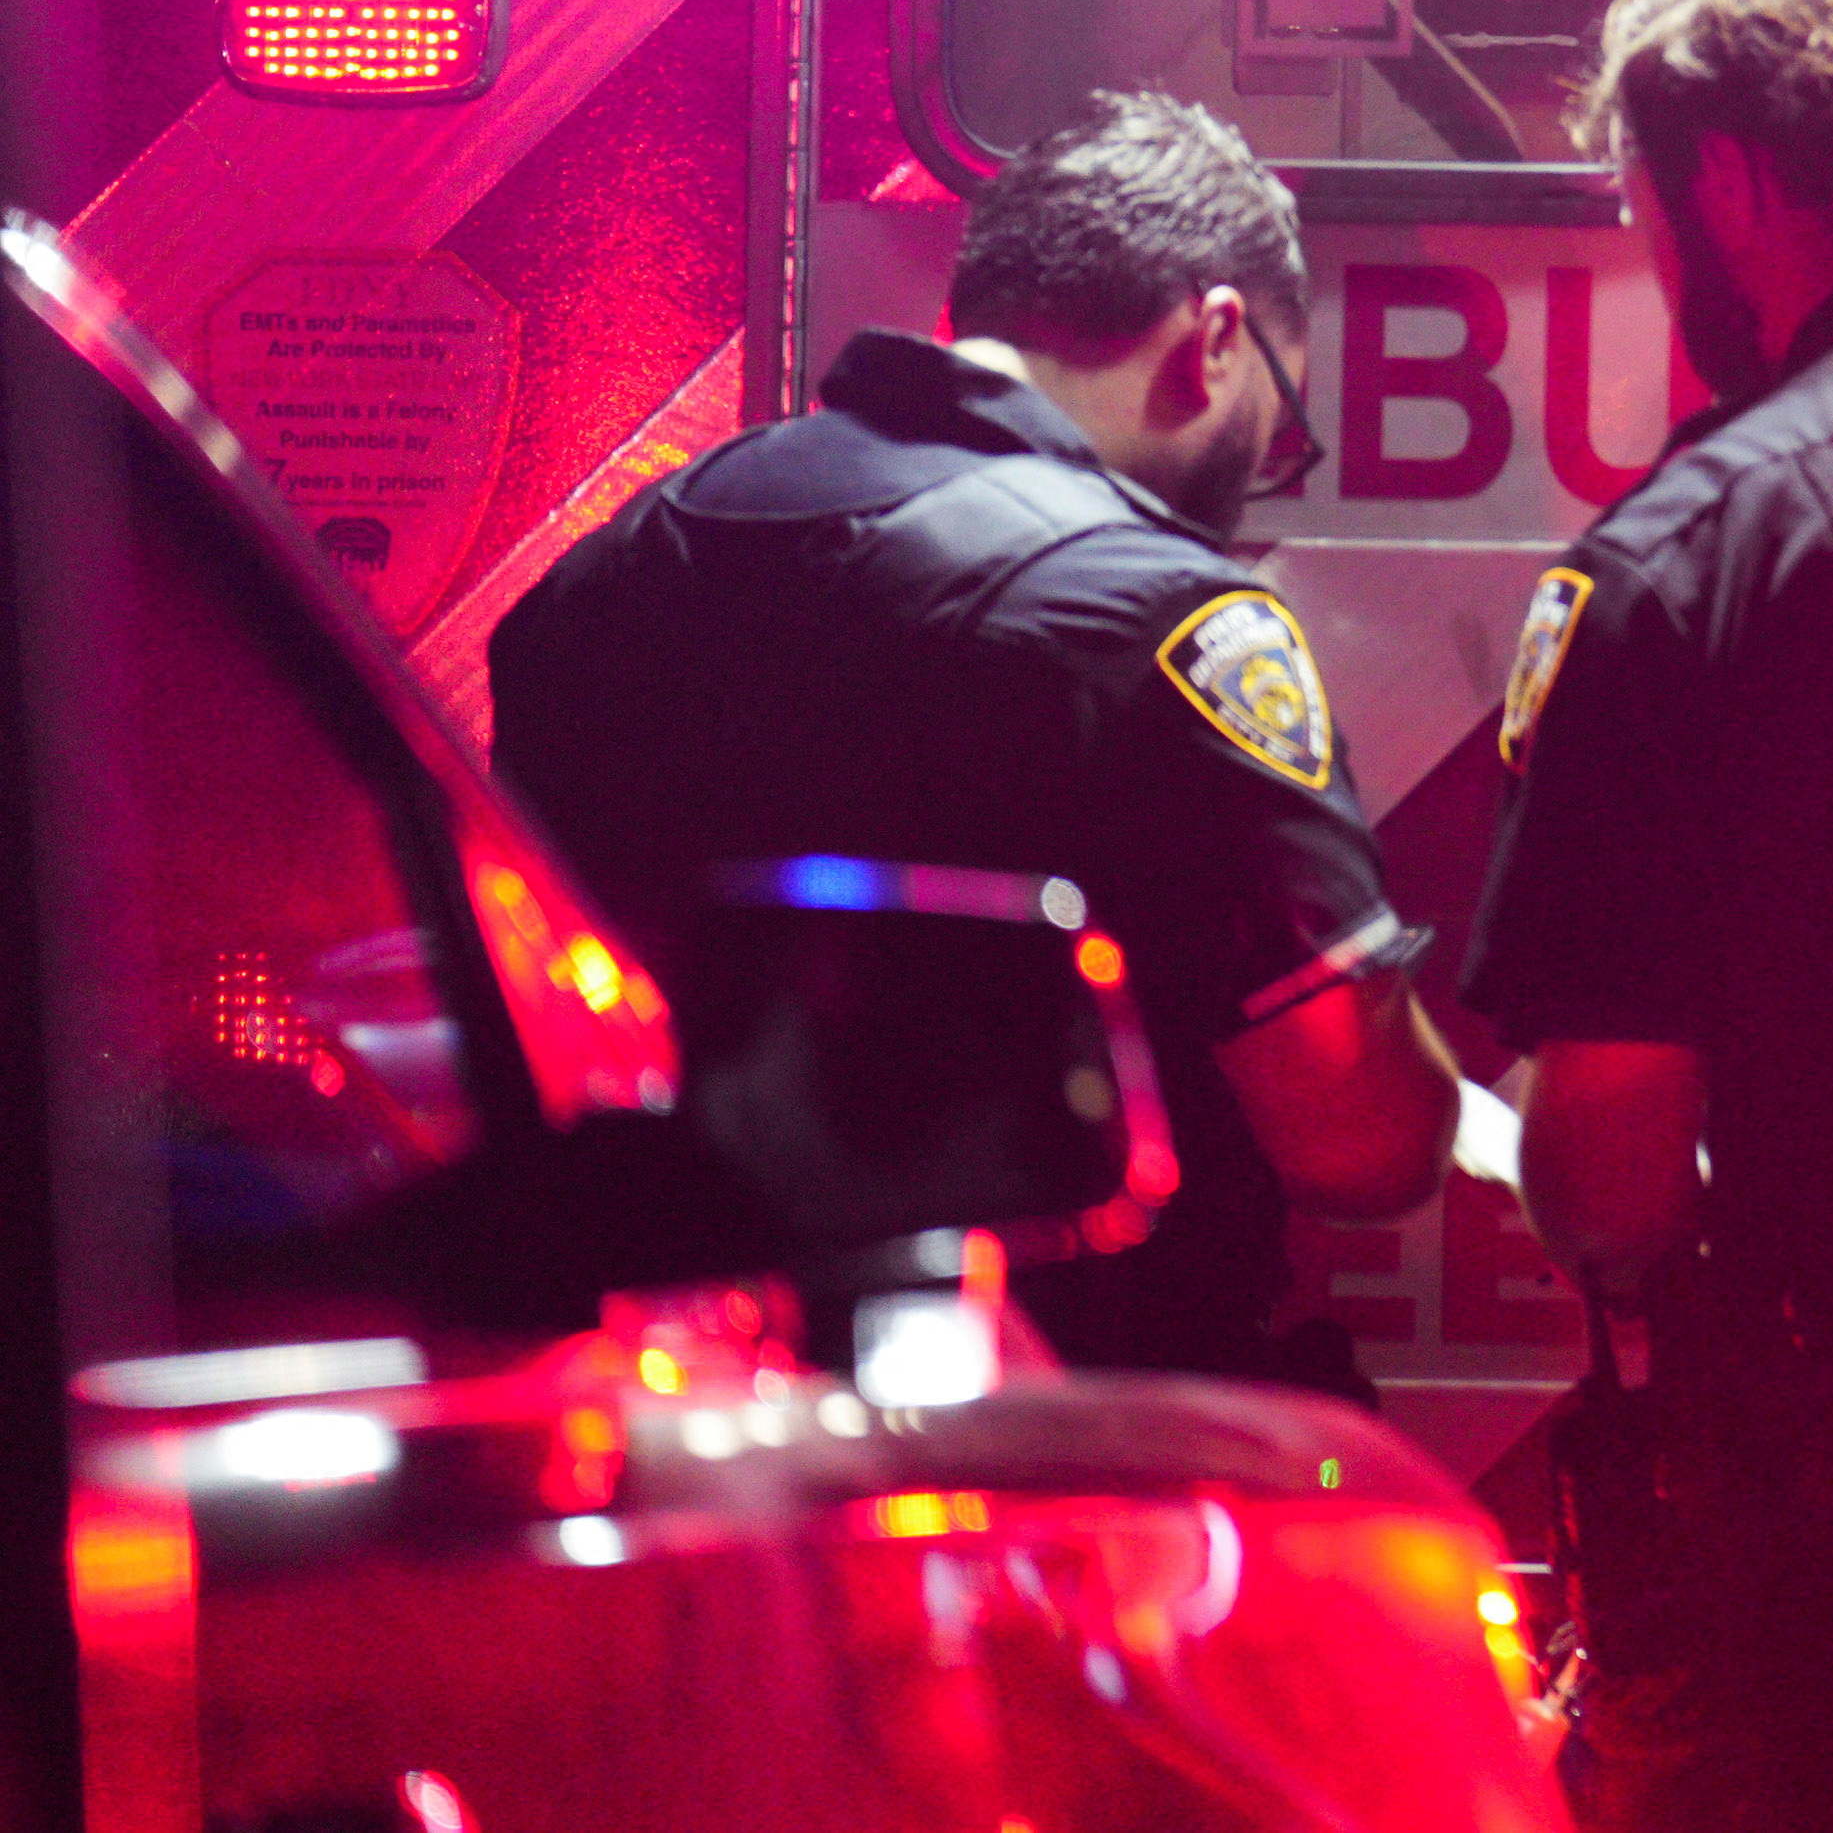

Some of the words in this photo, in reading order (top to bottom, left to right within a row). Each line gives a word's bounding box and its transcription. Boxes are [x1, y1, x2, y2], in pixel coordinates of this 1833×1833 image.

[240, 311, 298, 333] EMTs
[305, 312, 345, 333] and
[351, 313, 477, 334] Paramedics
[267, 339, 304, 358] Are
[310, 340, 413, 359] Protected
[418, 340, 448, 364] By
[256, 401, 335, 420] Assault
[342, 401, 360, 420] is
[367, 406, 381, 420] a
[387, 401, 457, 424] Felony
[280, 431, 399, 450] Punishable
[405, 431, 431, 455] by
[264, 458, 288, 490] 7
[287, 474, 346, 493] years
[351, 472, 371, 489] in
[377, 473, 446, 493] prison
